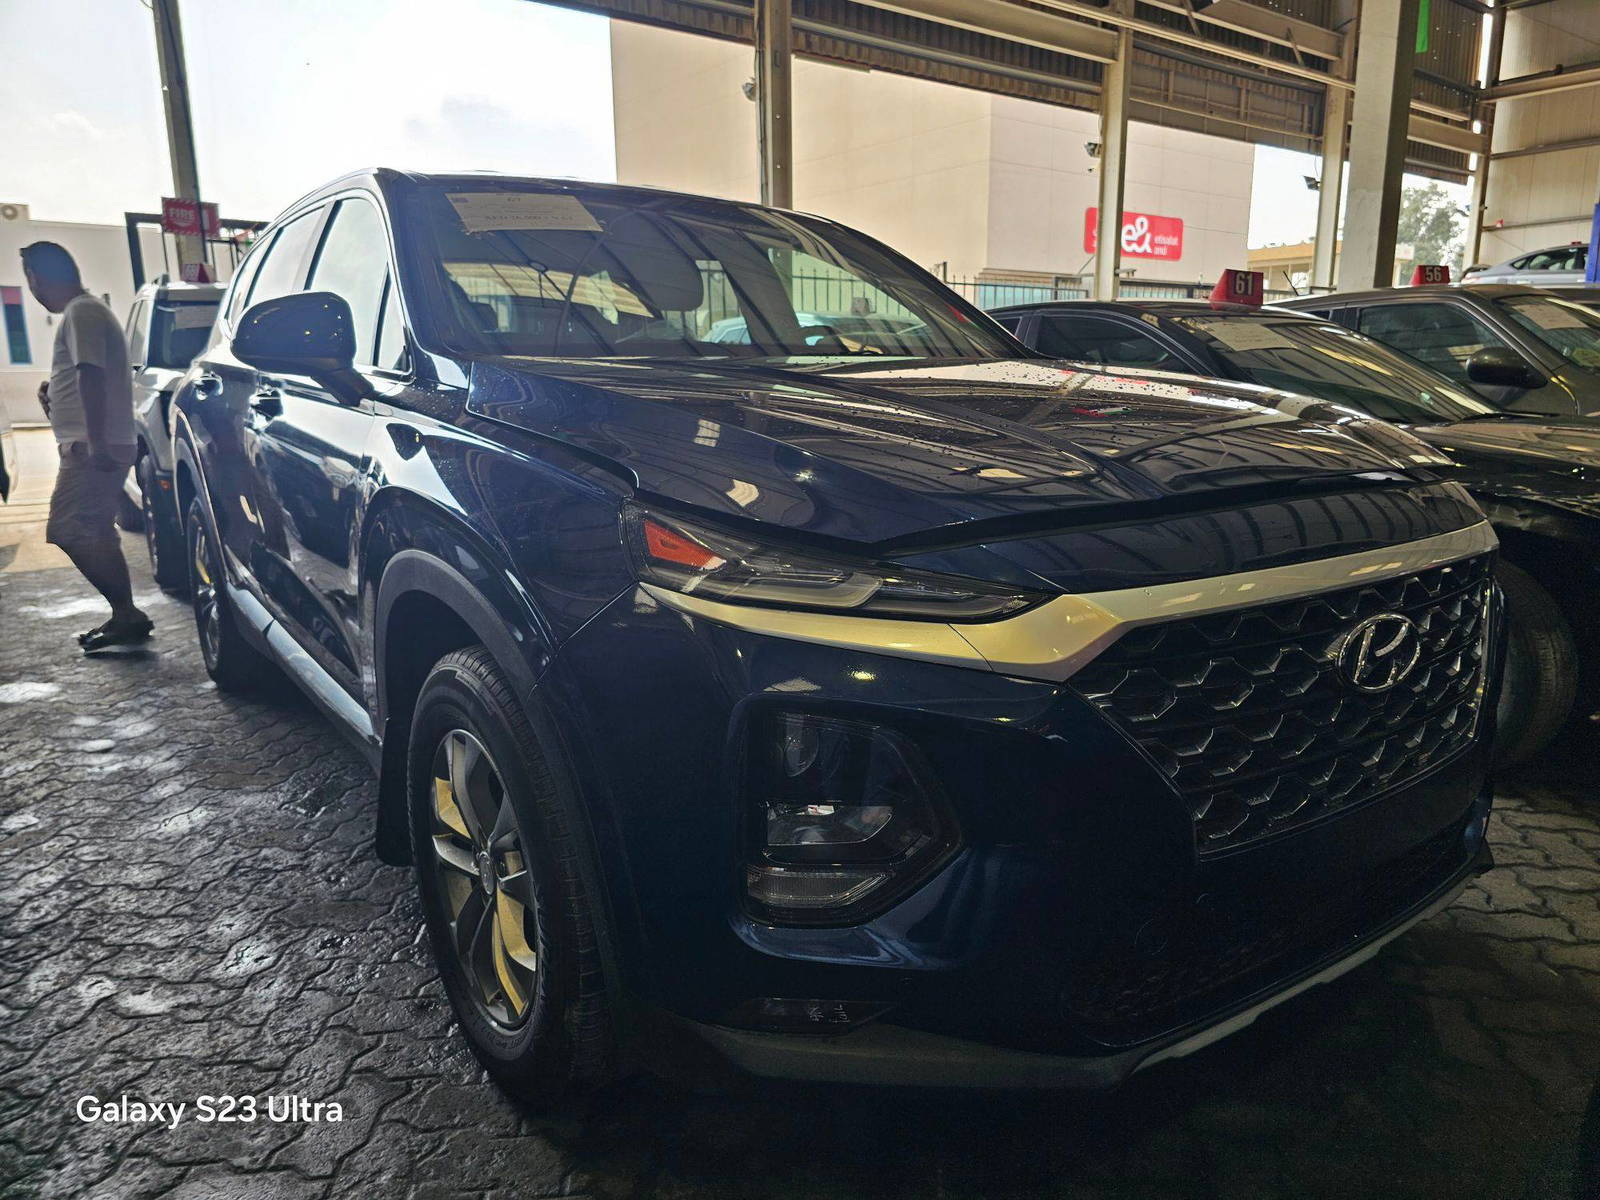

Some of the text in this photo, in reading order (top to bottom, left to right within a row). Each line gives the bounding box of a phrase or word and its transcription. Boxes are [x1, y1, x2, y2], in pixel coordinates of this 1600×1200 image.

[168, 207, 195, 220] FIRE
[1425, 266, 1442, 282] 56
[1235, 271, 1253, 296] 61
